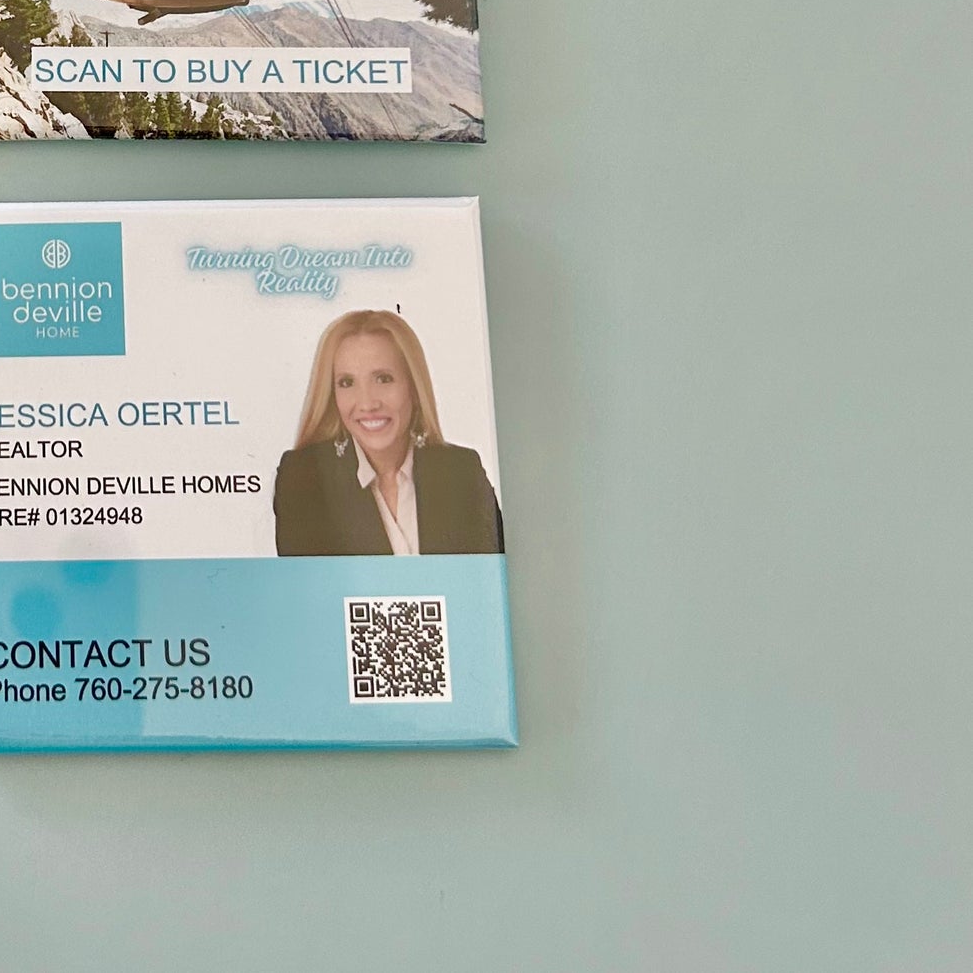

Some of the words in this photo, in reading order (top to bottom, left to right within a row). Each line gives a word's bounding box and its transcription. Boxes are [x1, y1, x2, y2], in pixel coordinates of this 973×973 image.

[36, 59, 121, 82] SCAN
[133, 60, 176, 83] TO
[188, 60, 252, 83] BUY
[262, 60, 284, 83] A
[292, 60, 407, 83] TICKET
[186, 247, 275, 272] Turning
[278, 246, 359, 270] Dream
[363, 244, 413, 267] Into
[2, 277, 112, 302] bennion
[256, 271, 340, 298] Reality
[13, 300, 103, 324] deville
[36, 327, 80, 338] HOME
[118, 402, 239, 426] OERTEL
[88, 476, 175, 495] DEVILLE
[183, 476, 260, 493] HOMES
[46, 507, 142, 525] 01324948
[165, 639, 210, 666] US
[75, 676, 252, 701] 760-275-8180
